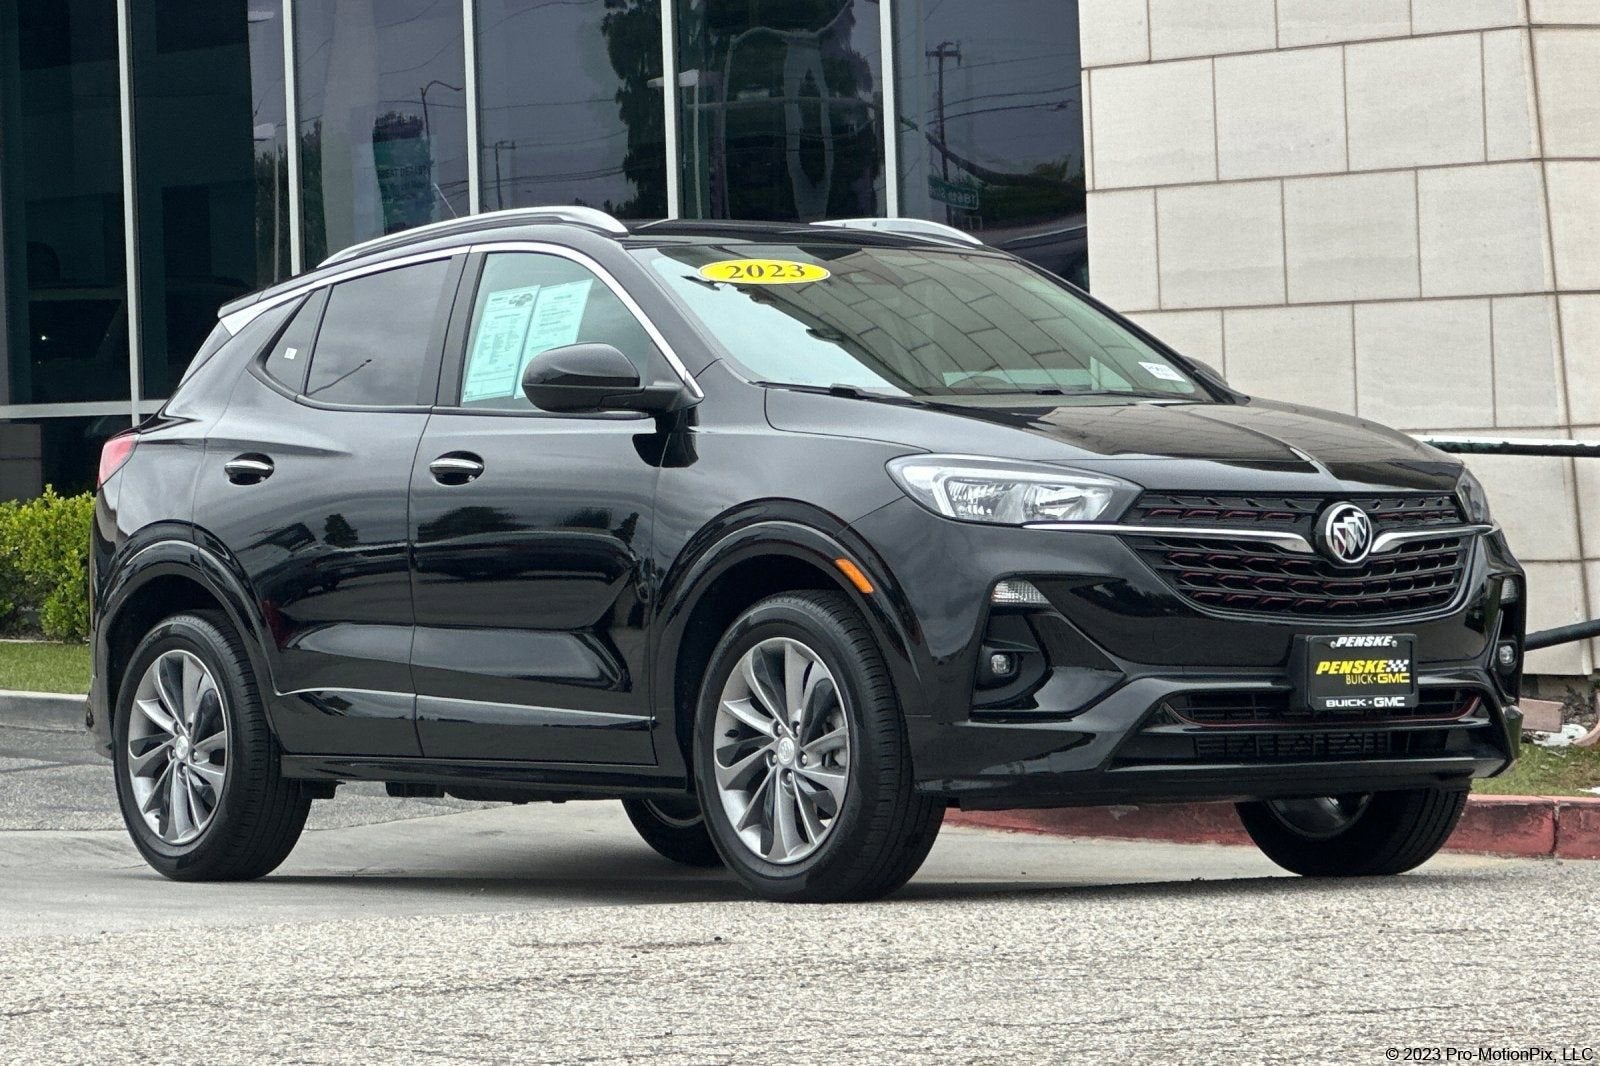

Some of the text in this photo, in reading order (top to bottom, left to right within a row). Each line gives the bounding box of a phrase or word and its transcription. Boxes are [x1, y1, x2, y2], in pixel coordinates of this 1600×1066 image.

[725, 264, 805, 279] 2023
[1336, 635, 1394, 648] PENSKE
[1316, 659, 1389, 675] PENSKE
[1345, 672, 1410, 685] BUICK GMC
[1326, 696, 1405, 708] BUICK GMC
